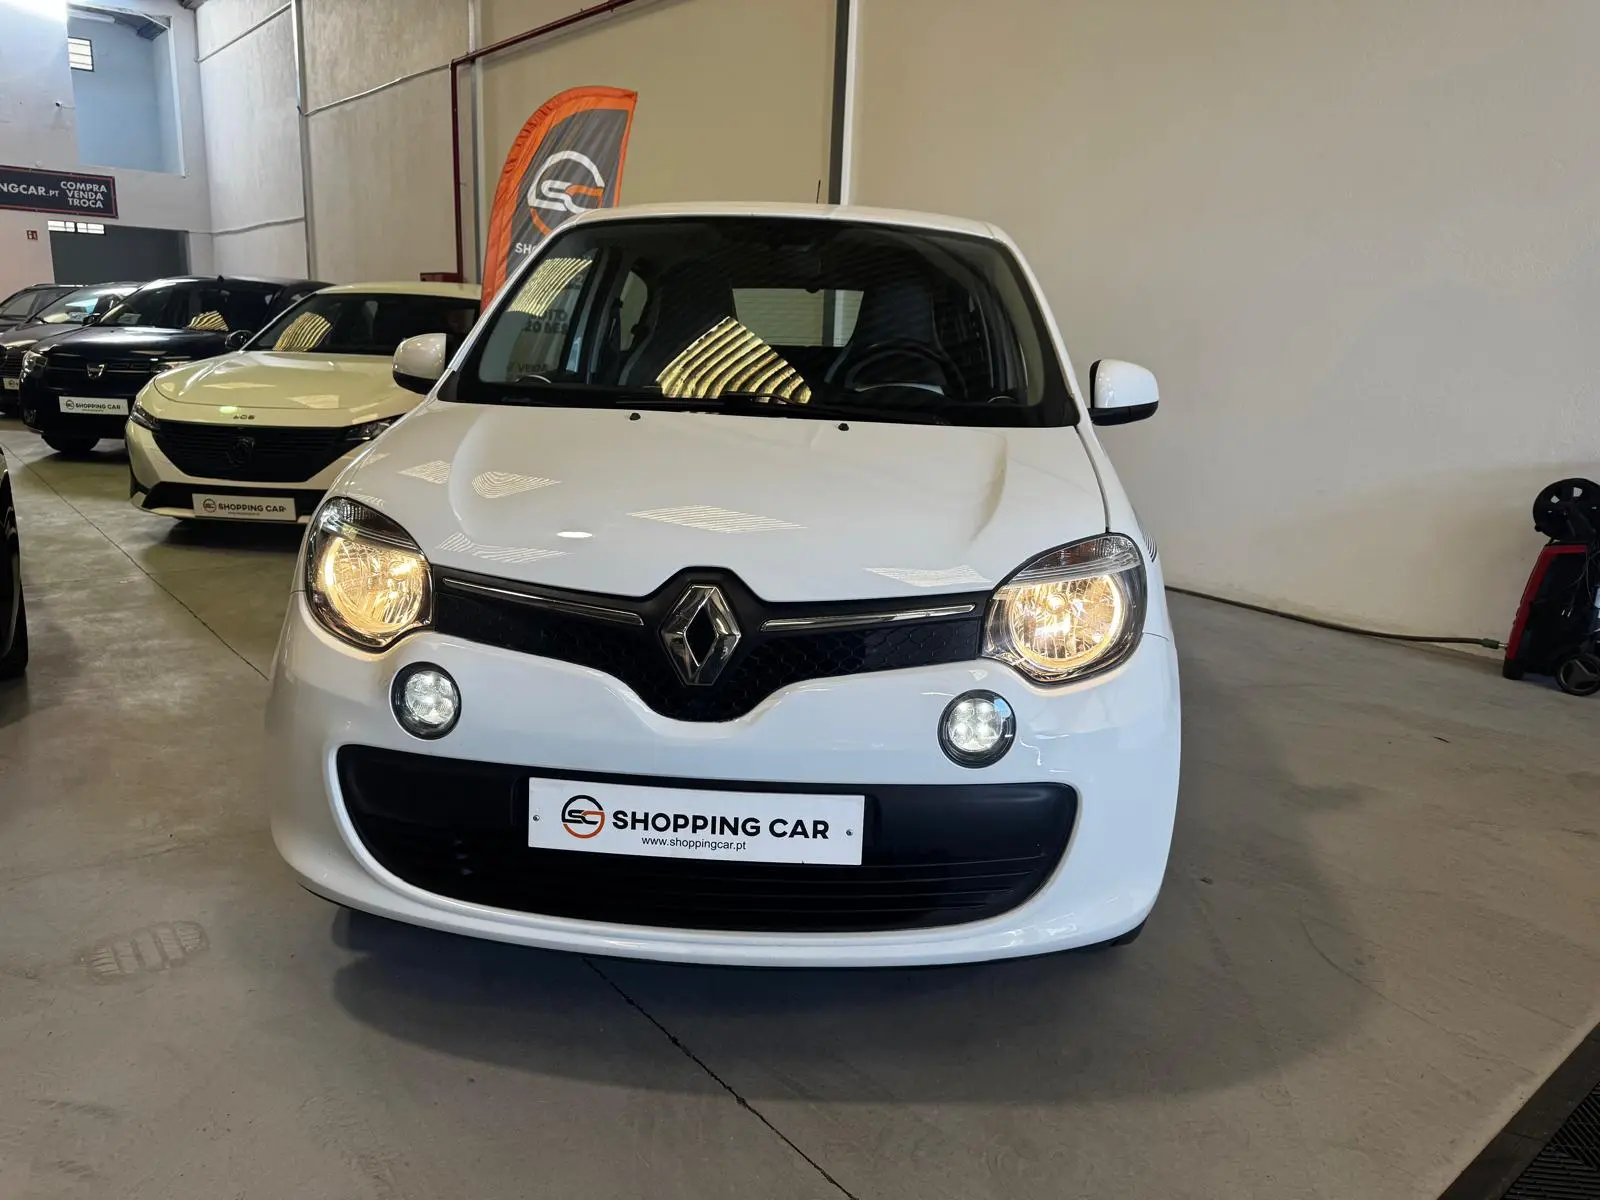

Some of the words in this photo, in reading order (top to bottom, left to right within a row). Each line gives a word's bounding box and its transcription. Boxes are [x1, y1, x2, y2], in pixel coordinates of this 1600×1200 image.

[60, 181, 108, 193] COMPRA
[66, 189, 104, 200] VENDA
[67, 198, 104, 208] TROCA
[218, 503, 264, 512] SHOPPING
[612, 809, 761, 837] SHOPPING
[769, 818, 830, 840] CAR
[641, 836, 747, 852] www.shoppingcar.pt
